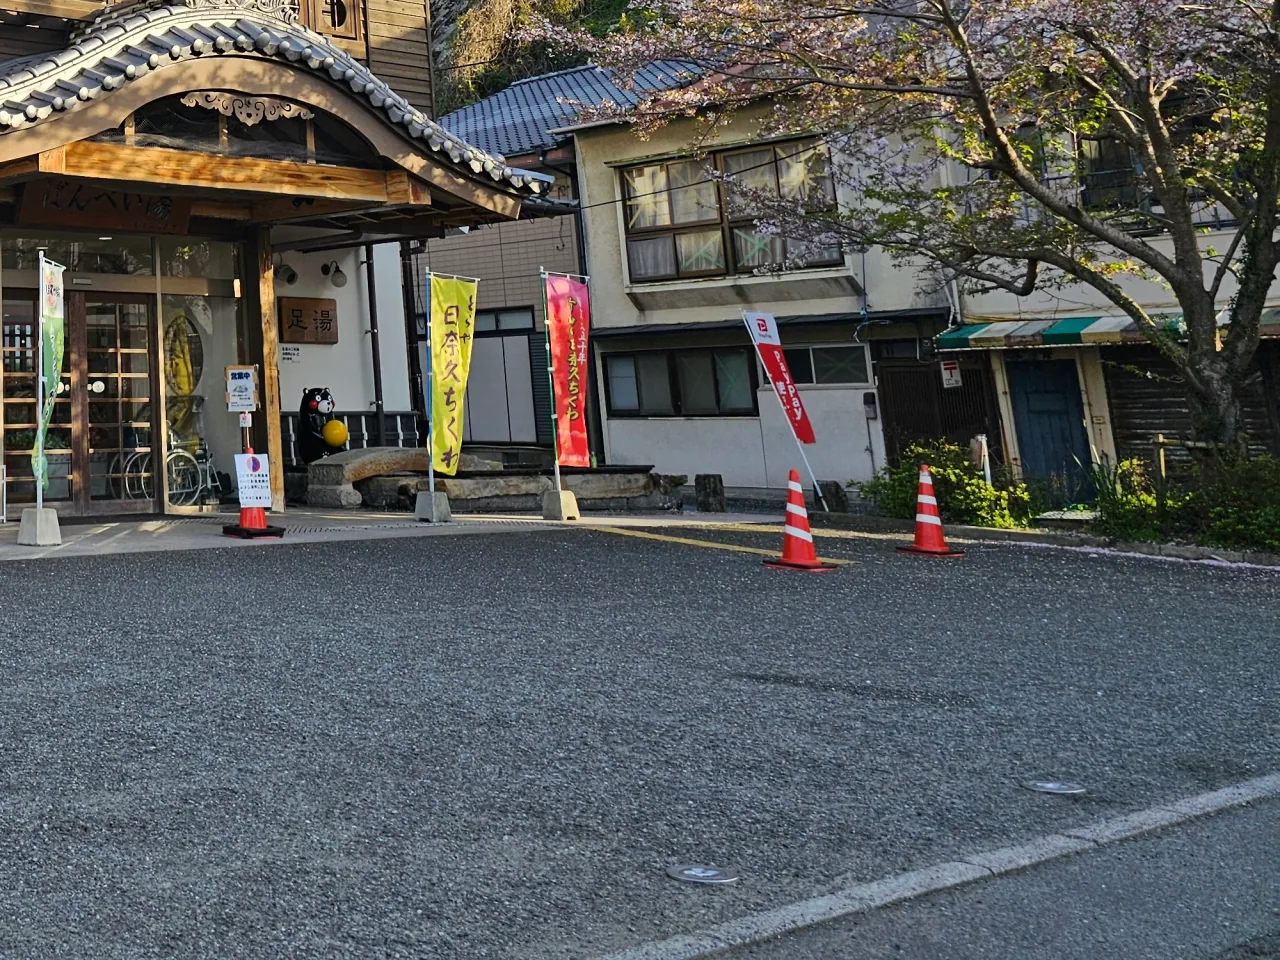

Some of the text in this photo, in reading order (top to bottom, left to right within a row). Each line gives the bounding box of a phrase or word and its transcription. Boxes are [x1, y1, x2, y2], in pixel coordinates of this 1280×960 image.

[288, 309, 333, 331] 足湯
[231, 372, 250, 380] 営業中
[440, 305, 461, 469] 日奈久ちくわ
[773, 350, 802, 420] PayPay
